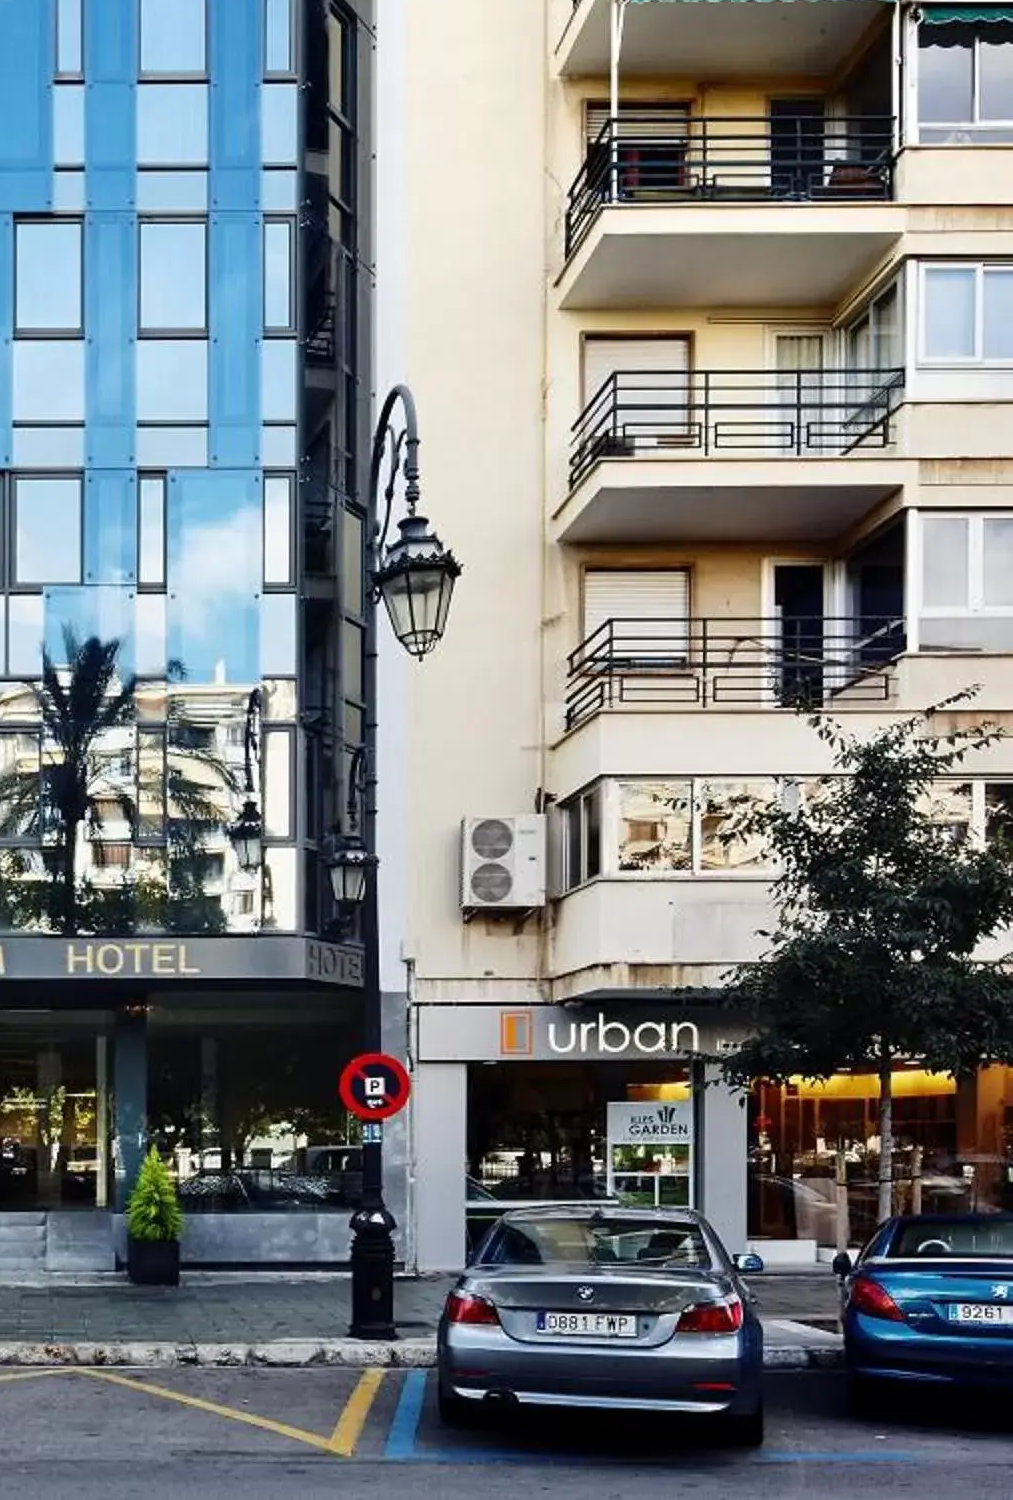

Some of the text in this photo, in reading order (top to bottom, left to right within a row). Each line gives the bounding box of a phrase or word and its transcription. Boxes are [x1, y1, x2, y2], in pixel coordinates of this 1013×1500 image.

[67, 943, 201, 975] HOTEL
[548, 1012, 699, 1053] urban
[370, 1080, 380, 1093] P
[628, 1123, 688, 1135] GARDEN
[962, 1305, 1003, 1320] 9261
[594, 1315, 628, 1332] FWP
